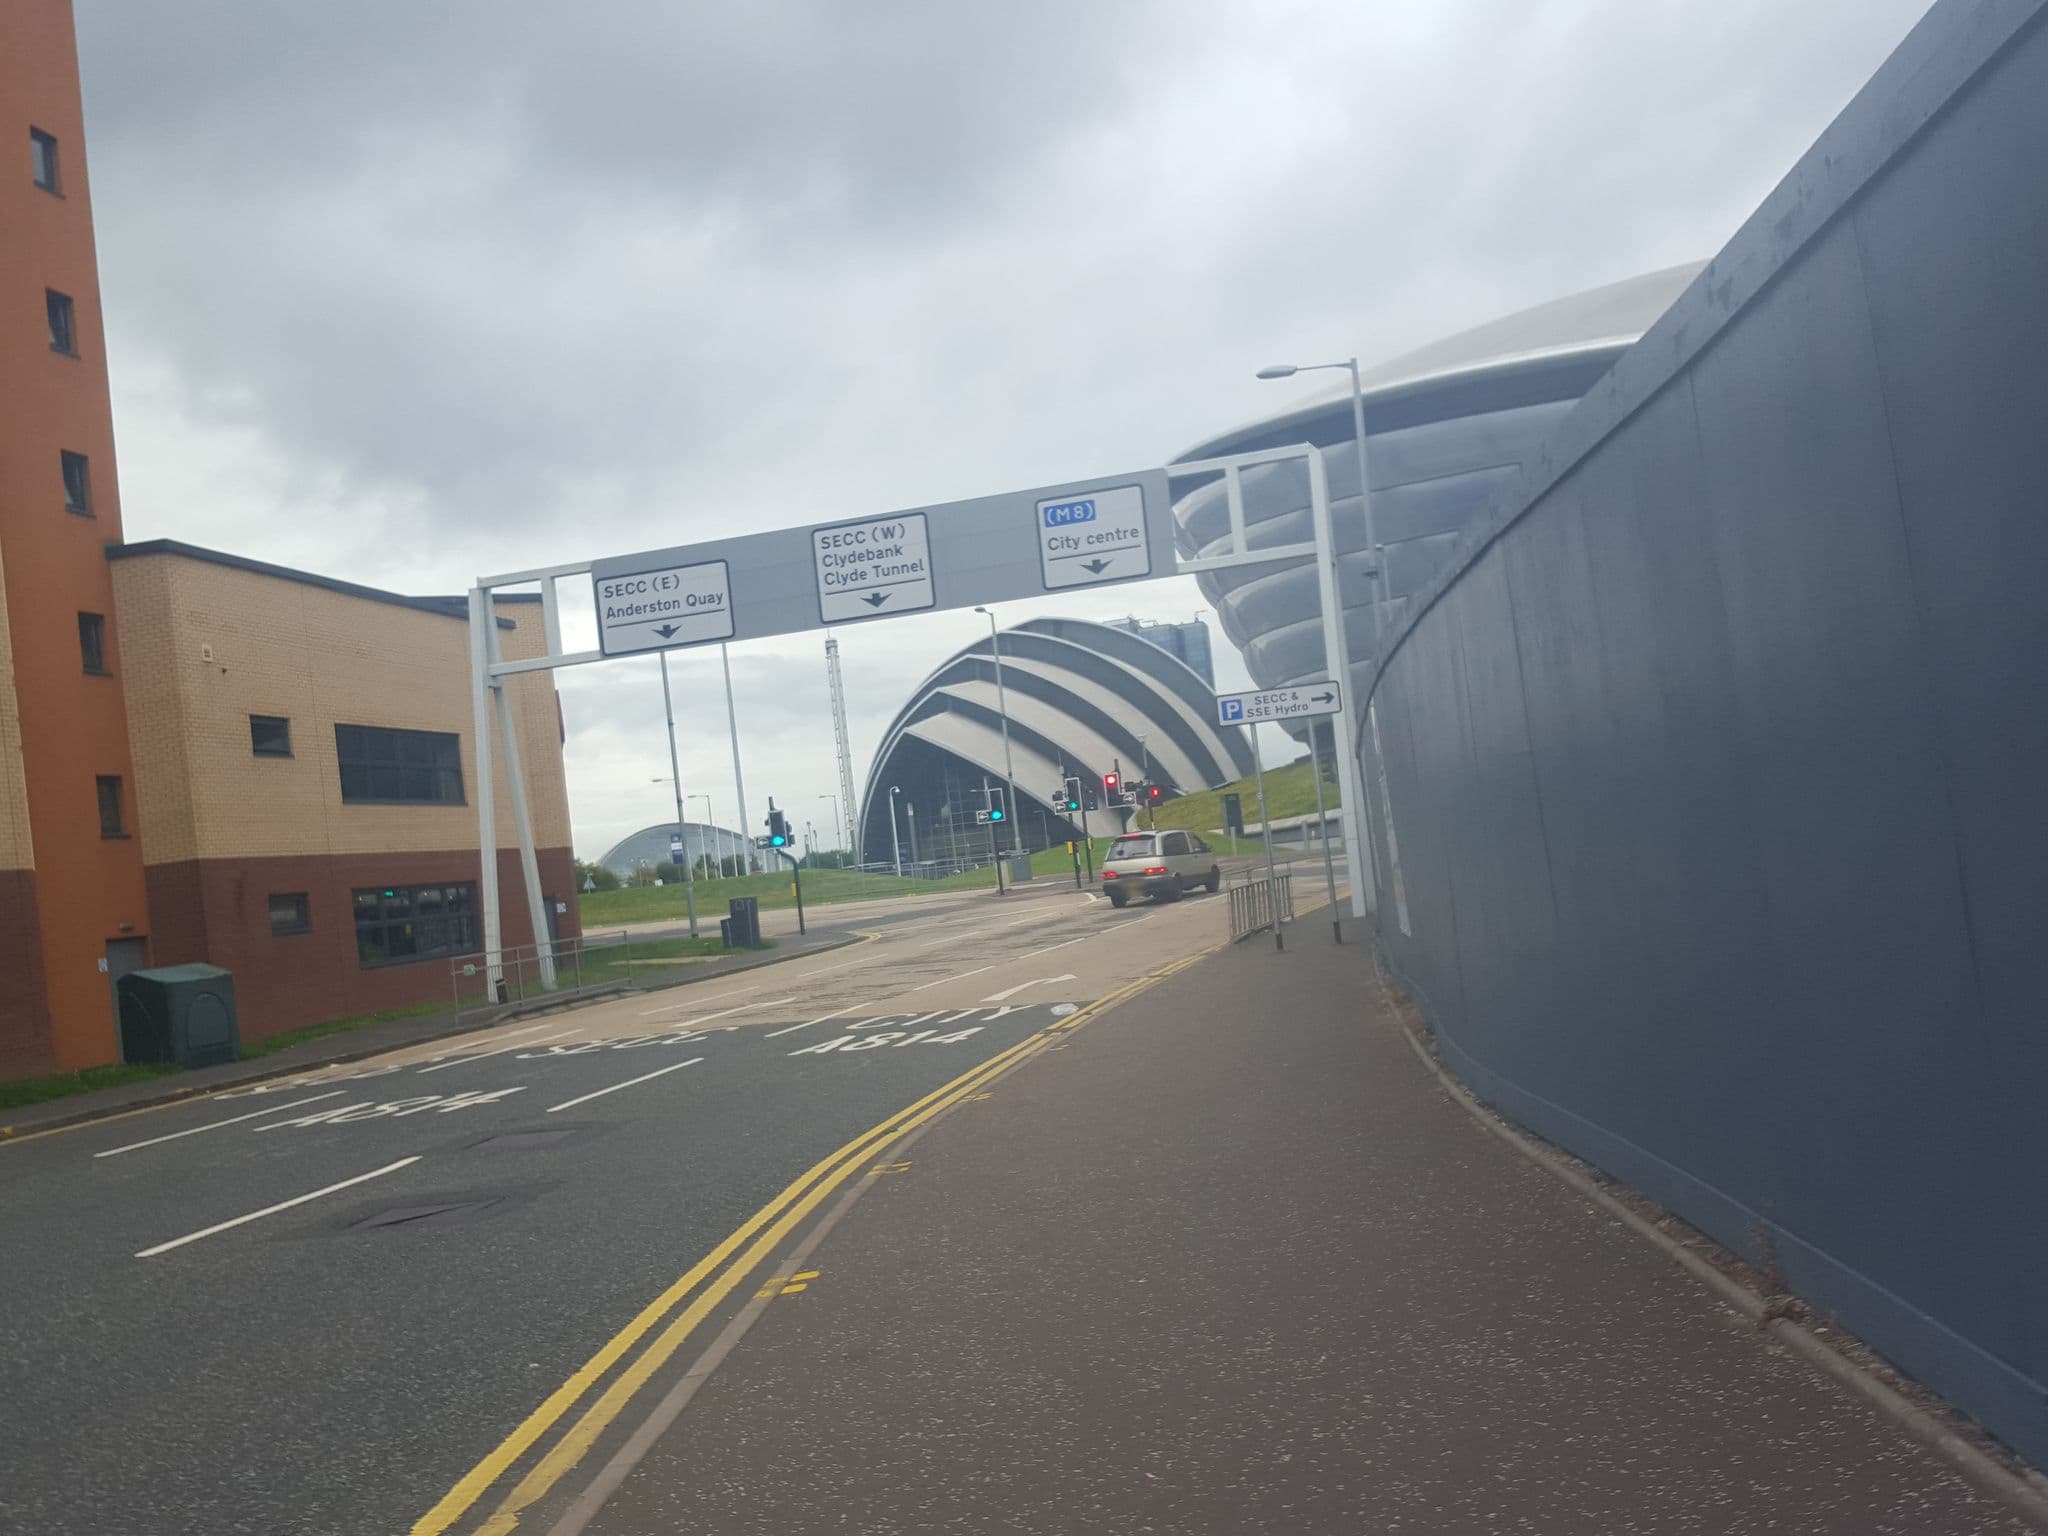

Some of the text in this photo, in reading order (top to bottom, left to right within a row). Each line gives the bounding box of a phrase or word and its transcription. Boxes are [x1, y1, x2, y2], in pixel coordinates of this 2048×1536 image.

[1047, 502, 1093, 525] (M8)
[821, 523, 905, 549] SECC (W)
[1047, 527, 1139, 551] City centre
[822, 544, 903, 568] Clydebank
[824, 558, 924, 586] Clyde Tunnel
[604, 574, 680, 598] SECC (E)
[607, 592, 723, 619] Anderston Quay
[1254, 691, 1299, 705] SECC &
[1247, 703, 1309, 718] SSE Hydro
[846, 1004, 1038, 1029] CITY
[787, 1026, 985, 1056] A814
